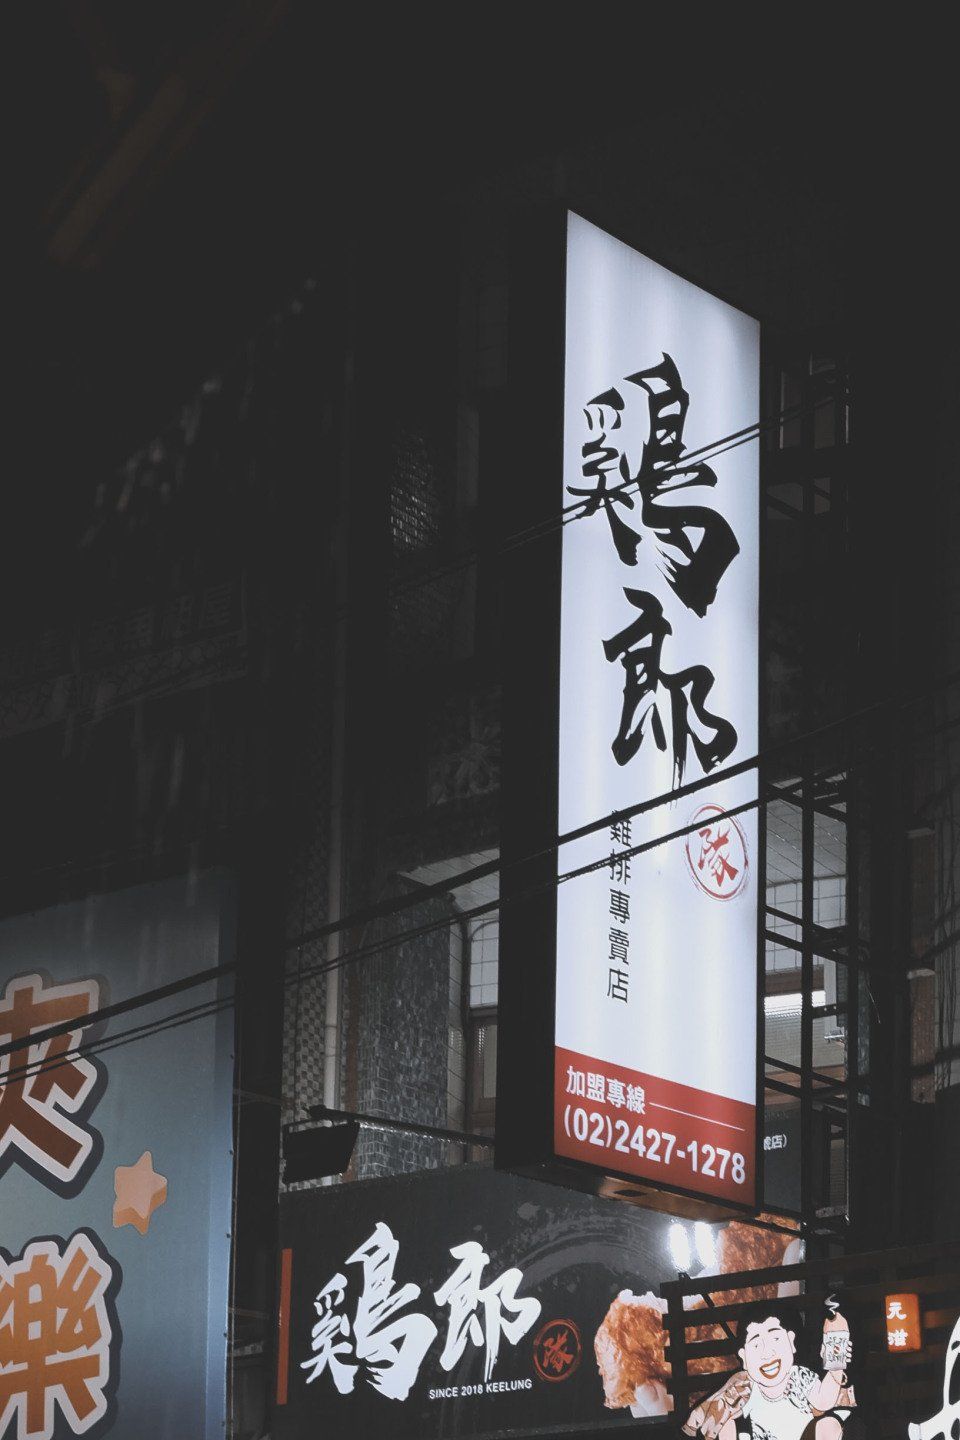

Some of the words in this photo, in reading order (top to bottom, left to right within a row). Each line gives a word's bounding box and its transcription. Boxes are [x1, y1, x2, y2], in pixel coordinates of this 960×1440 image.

[606, 810, 632, 1003] 雞排專賣店
[566, 1066, 646, 1115] 加盟專線
[563, 1104, 746, 1186] (02)2427-1278
[429, 1386, 459, 1400] SINCE
[461, 1384, 484, 1397] 2018
[486, 1379, 533, 1394] KEELUNG
